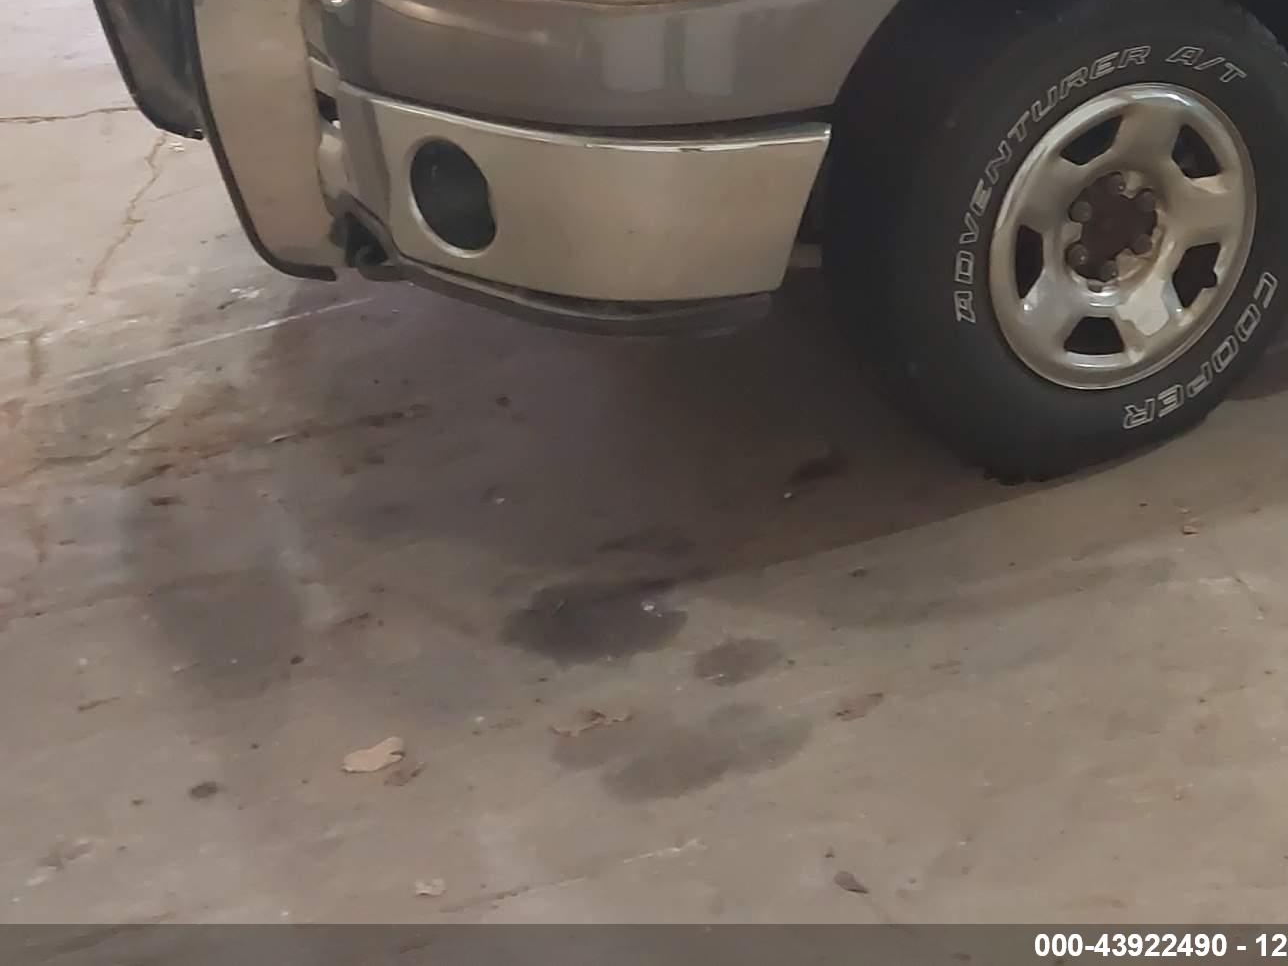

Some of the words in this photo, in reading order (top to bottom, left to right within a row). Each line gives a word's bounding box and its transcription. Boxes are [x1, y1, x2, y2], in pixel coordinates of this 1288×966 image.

[954, 45, 1152, 324] ADVENTURER
[1165, 45, 1248, 84] A/T
[1122, 271, 1280, 430] COOPER
